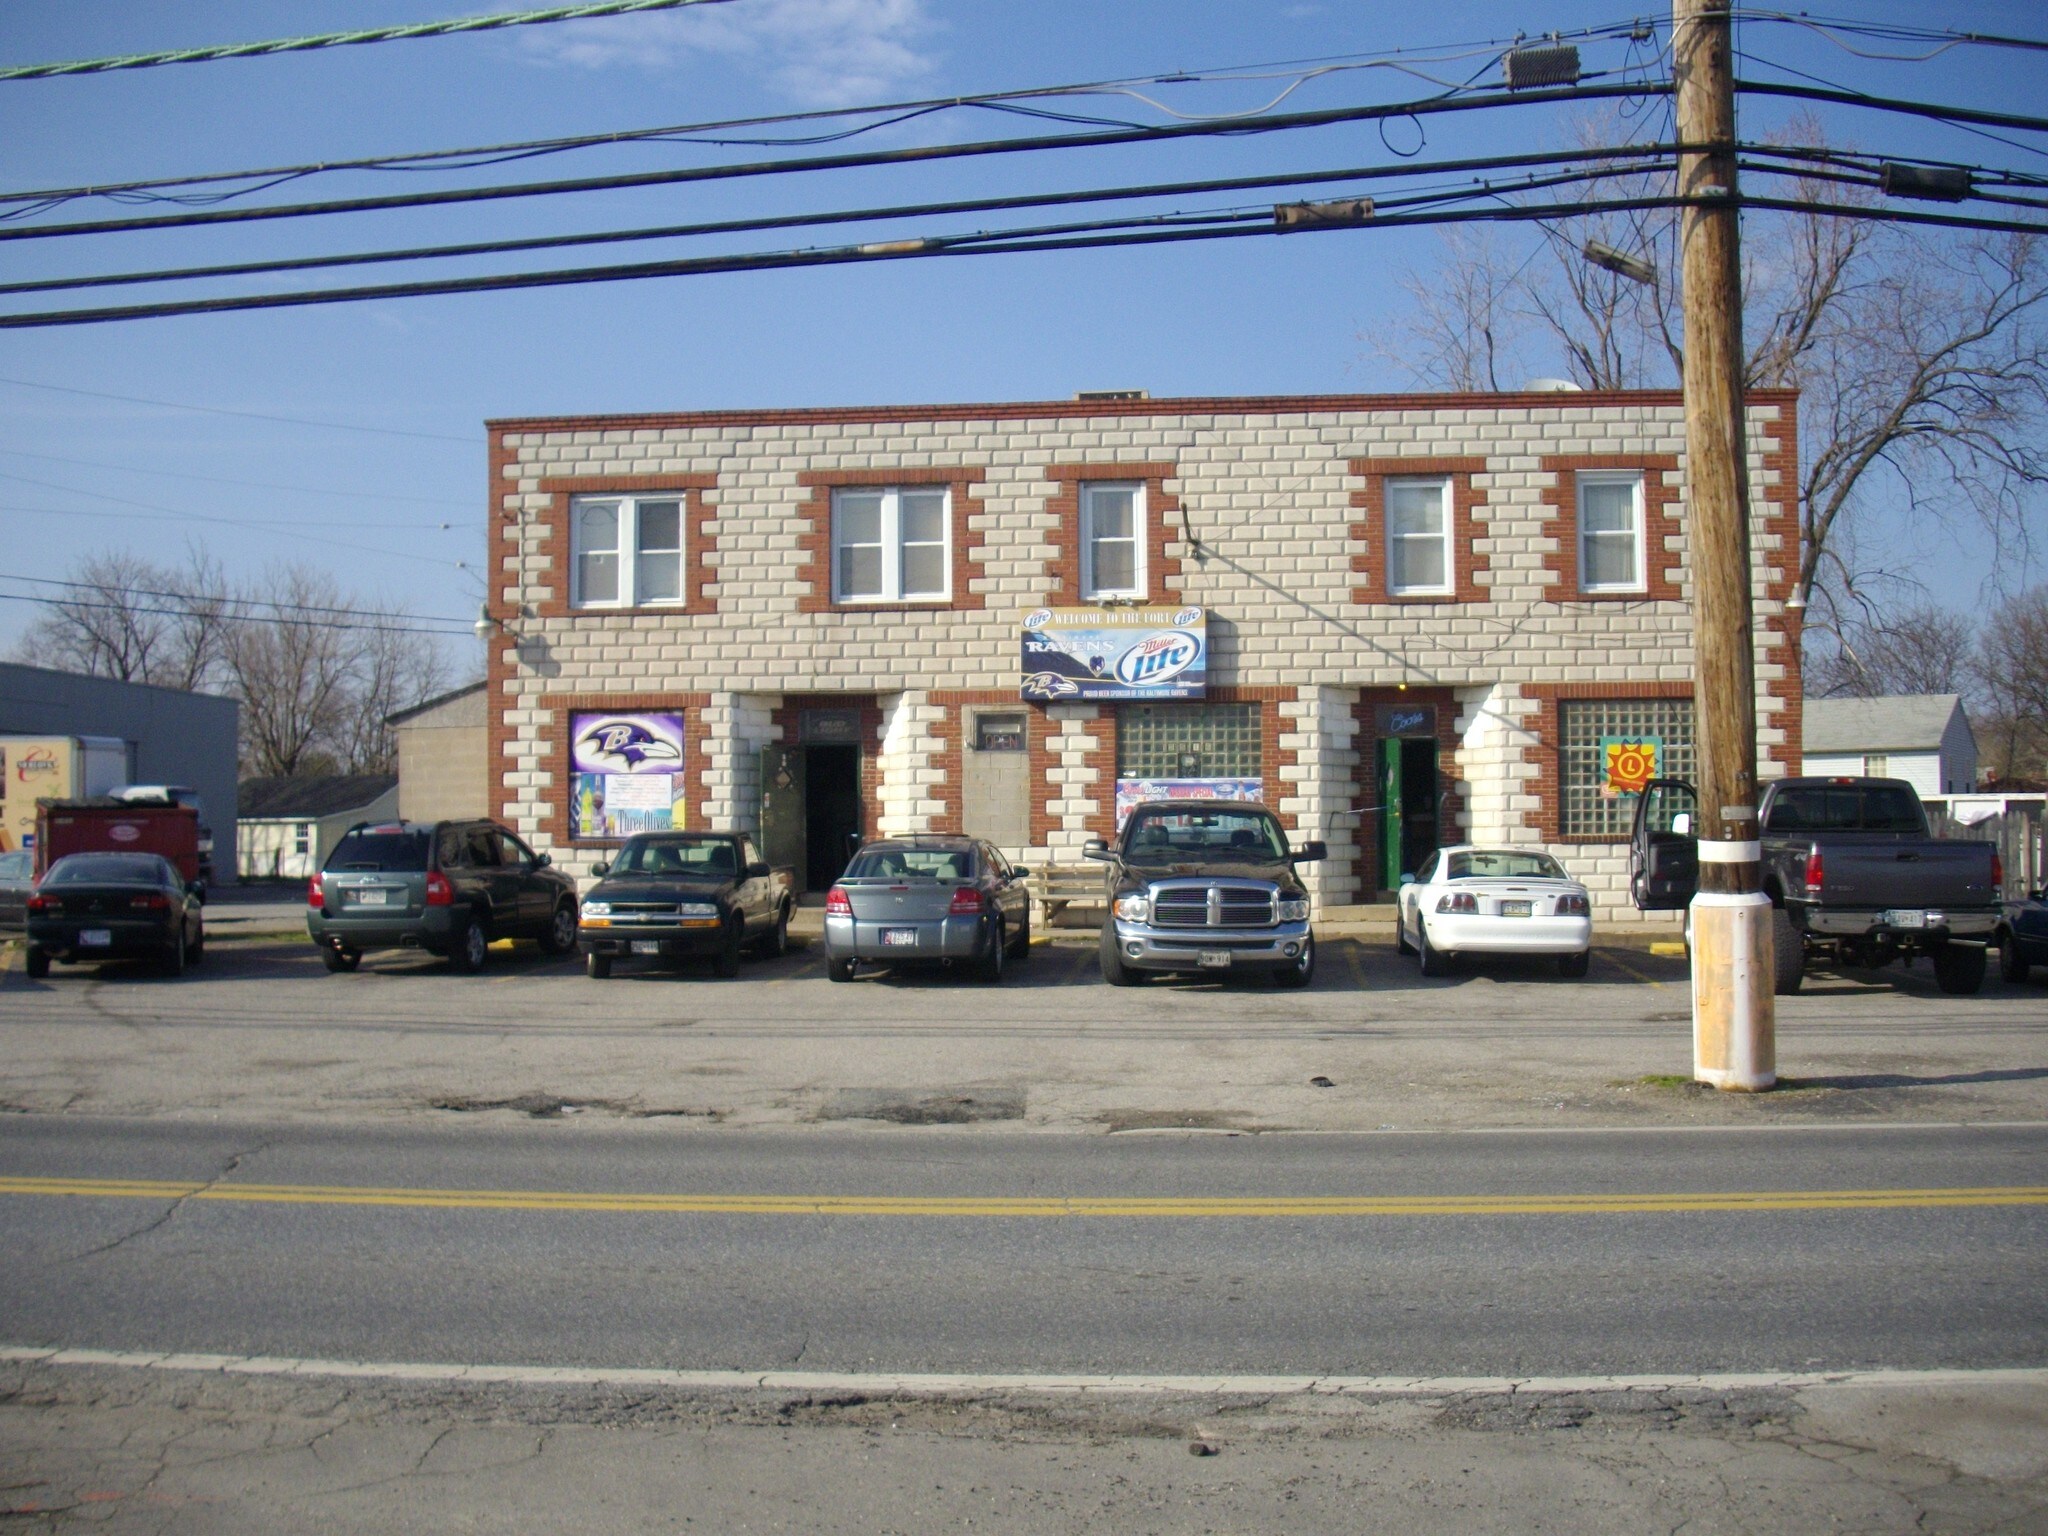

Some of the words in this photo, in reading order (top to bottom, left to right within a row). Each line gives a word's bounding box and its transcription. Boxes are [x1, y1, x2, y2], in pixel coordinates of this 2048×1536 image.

[1055, 613, 1102, 624] WELCOME
[1106, 613, 1118, 624] TO
[1122, 612, 1139, 624] THE
[1144, 612, 1169, 623] FORT
[1025, 641, 1115, 653] RAVENS
[1138, 638, 1178, 655] Miller
[1130, 645, 1189, 684] Lite
[1627, 759, 1636, 773] L
[1145, 786, 1168, 794] LIGHT
